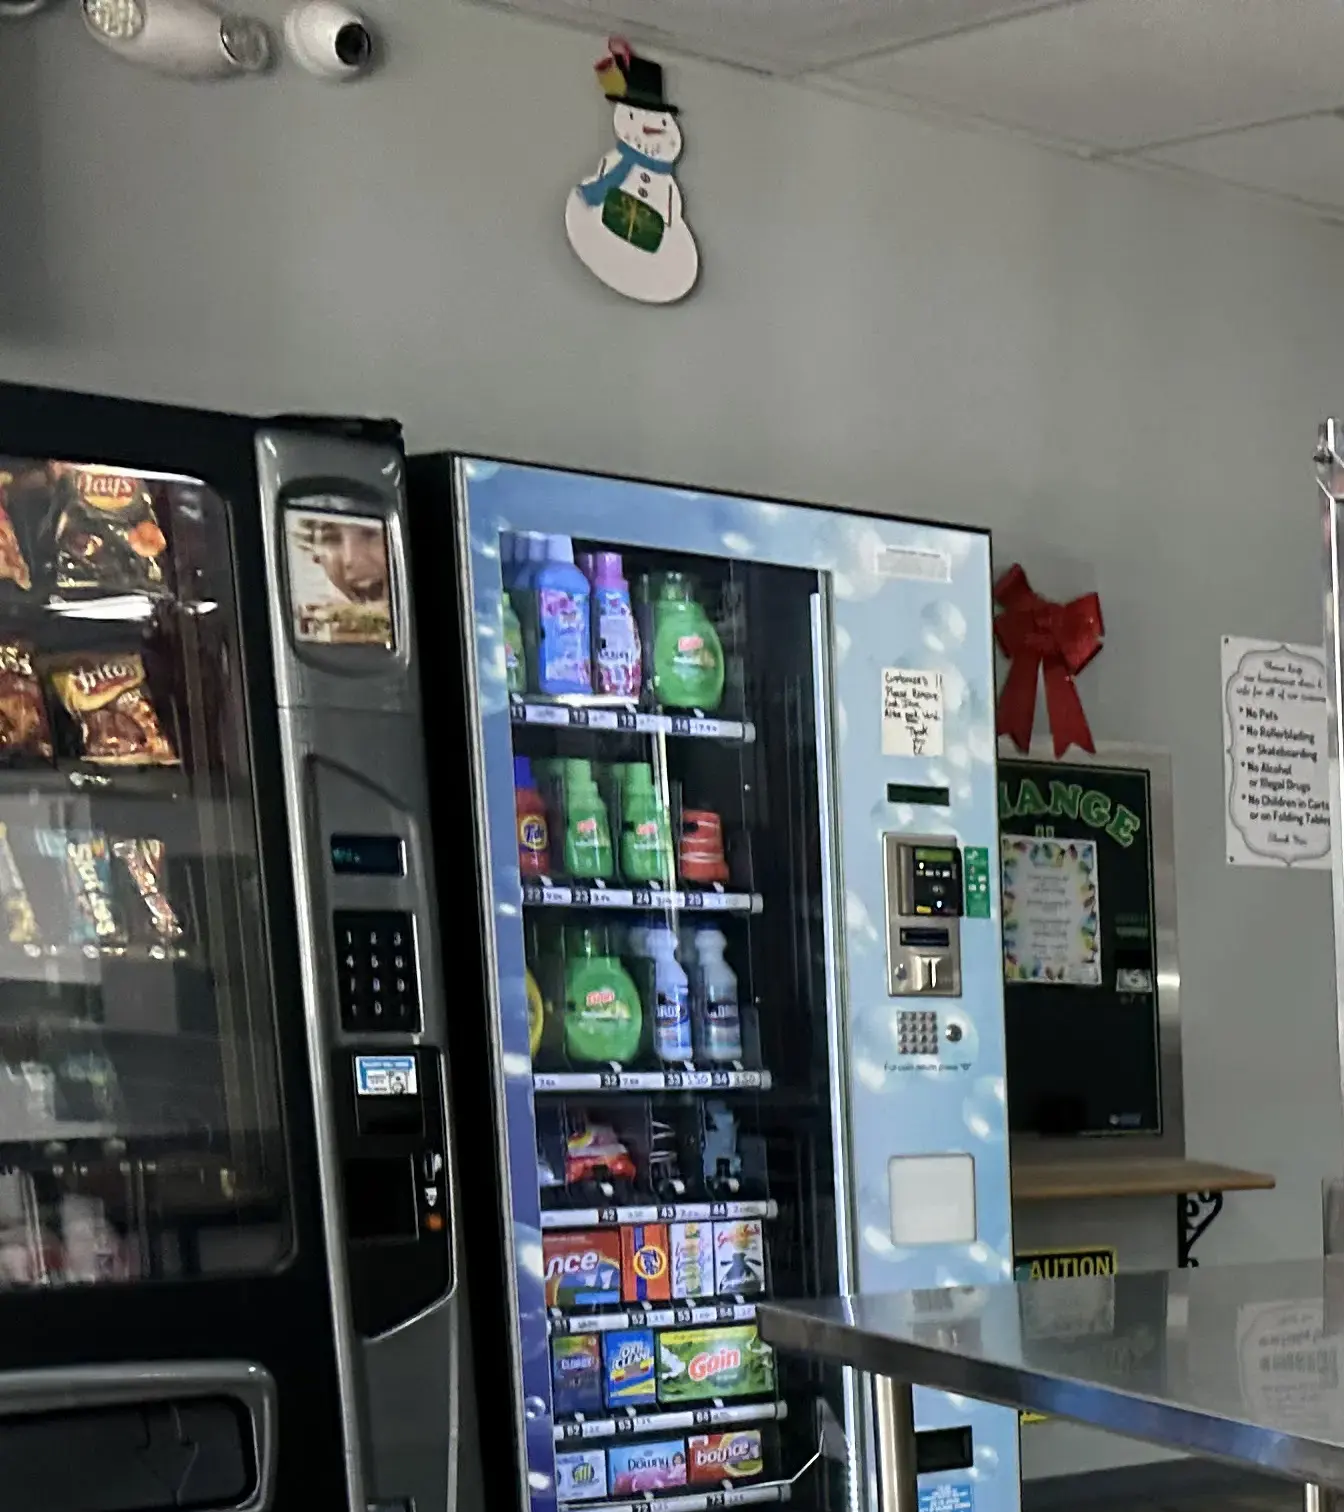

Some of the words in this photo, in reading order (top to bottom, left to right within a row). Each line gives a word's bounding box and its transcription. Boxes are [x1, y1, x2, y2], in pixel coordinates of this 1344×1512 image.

[1246, 706, 1258, 719] No
[1259, 707, 1279, 721] Pets
[1246, 725, 1258, 737] No
[1260, 725, 1315, 745] Rollerblading
[1258, 744, 1317, 763] Skateboarding
[1247, 761, 1259, 774] No
[1261, 761, 1292, 775] Alcohol
[1248, 793, 1260, 806] No
[1261, 794, 1297, 808] Children
[1000, 778, 1142, 849] ANGE
[1273, 810, 1304, 827] Folding
[602, 1209, 616, 1221] 42
[545, 1250, 600, 1281] nce
[1030, 1255, 1110, 1281] AUTION
[688, 1348, 741, 1382] Gain
[628, 1455, 669, 1472] Downy
